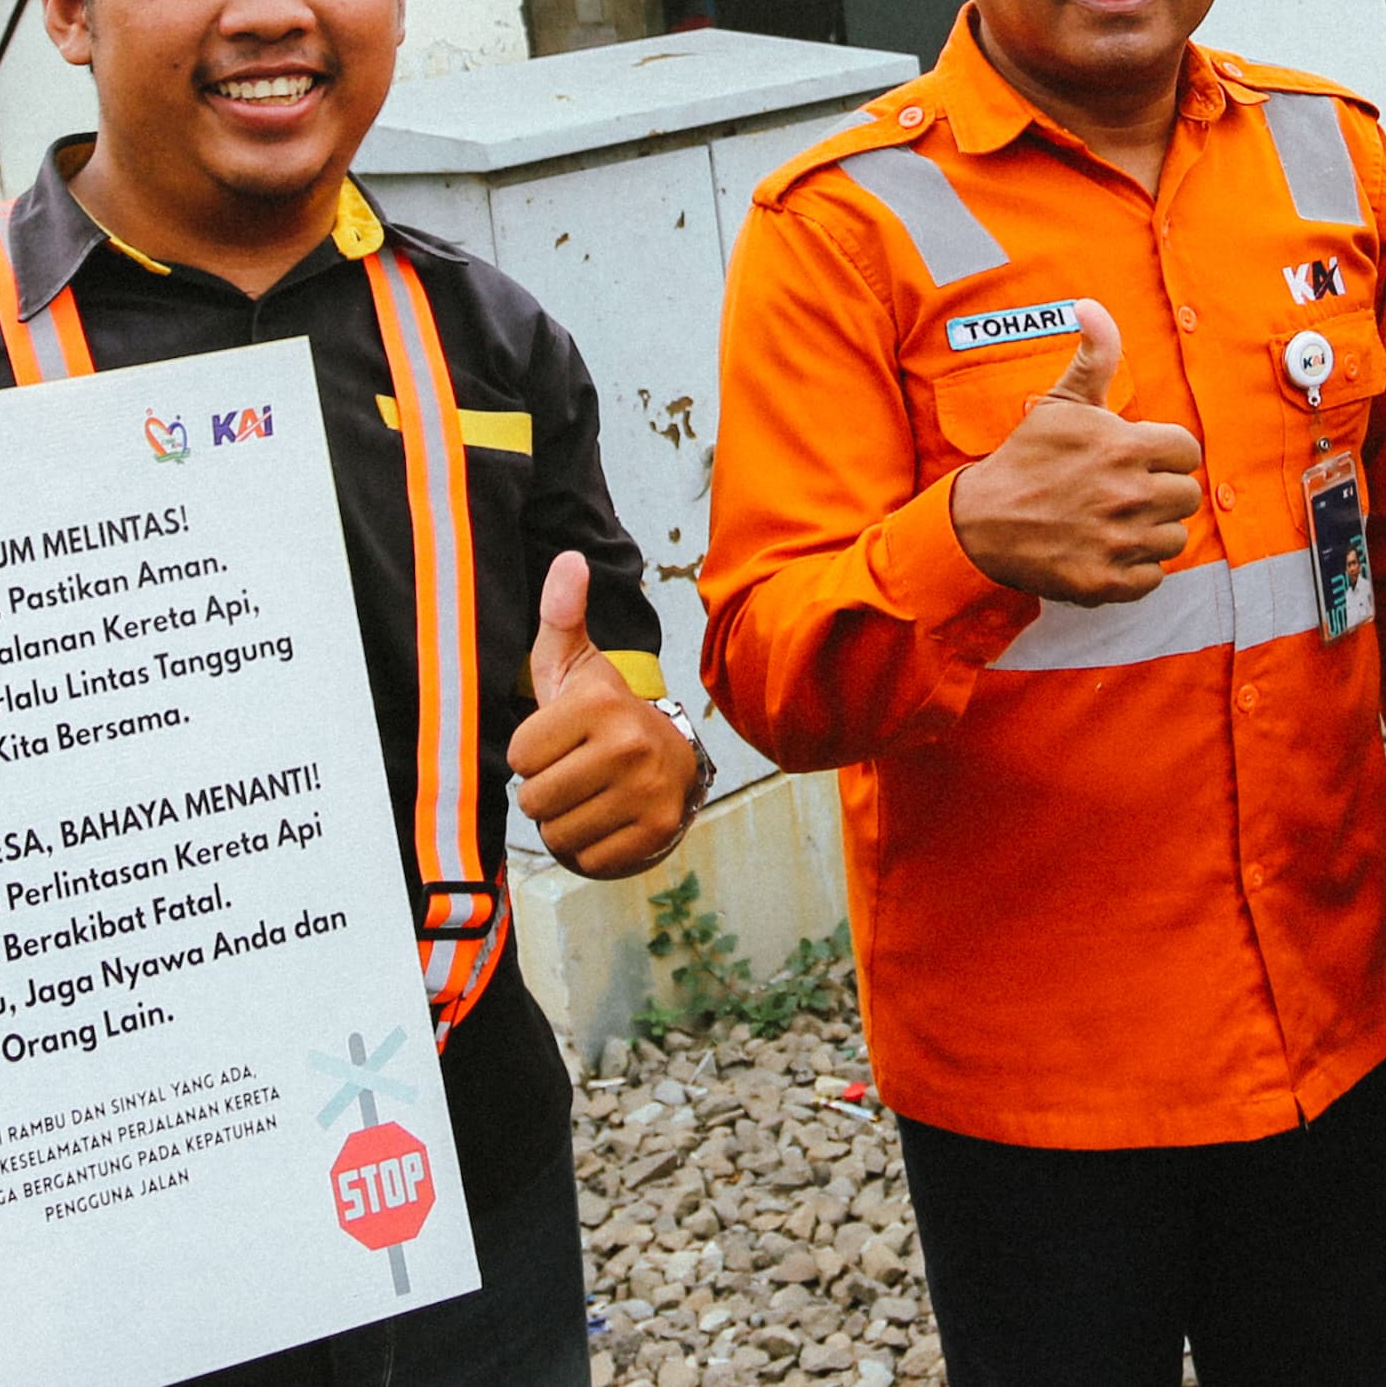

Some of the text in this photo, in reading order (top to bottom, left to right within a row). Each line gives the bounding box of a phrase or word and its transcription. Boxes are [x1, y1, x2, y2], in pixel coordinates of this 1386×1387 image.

[963, 308, 1065, 340] TOHARI
[41, 504, 190, 560] MELINTAS!
[7, 572, 130, 615] Pastikan
[137, 557, 228, 590] Aman.
[101, 606, 197, 644] Kereta
[204, 588, 260, 627] Api,
[64, 666, 150, 700] Lintas
[152, 635, 294, 681] Tanggung
[55, 707, 190, 751] Bersama.
[59, 797, 181, 849] BAHAYA
[184, 761, 322, 821] MENANTI!
[5, 857, 169, 912] Perlintasan
[173, 831, 270, 872] Kereta
[276, 810, 323, 850] Api
[2, 905, 148, 963] Berakibat
[151, 881, 233, 926] Fatal.
[24, 974, 95, 1009] Jaga
[100, 946, 205, 991] Nyawa
[212, 919, 287, 961] Anda
[293, 908, 348, 940] dan
[1, 1000, 175, 1063] Orang Lain.
[7, 1112, 66, 1143] RAMBU
[70, 1101, 107, 1126] DAN
[110, 1087, 167, 1115] SINYAL
[170, 1073, 215, 1098] YANG
[220, 1064, 257, 1086] ADA,
[117, 1101, 220, 1143] PERJALANAN
[223, 1085, 281, 1114] KERETA
[22, 1154, 133, 1199] BERGANTUNG
[137, 1142, 182, 1167] PADA
[185, 1114, 278, 1154] KEPATUHAN
[337, 1151, 425, 1221] STOP
[44, 1167, 190, 1223] PENGGUNA JALAN
